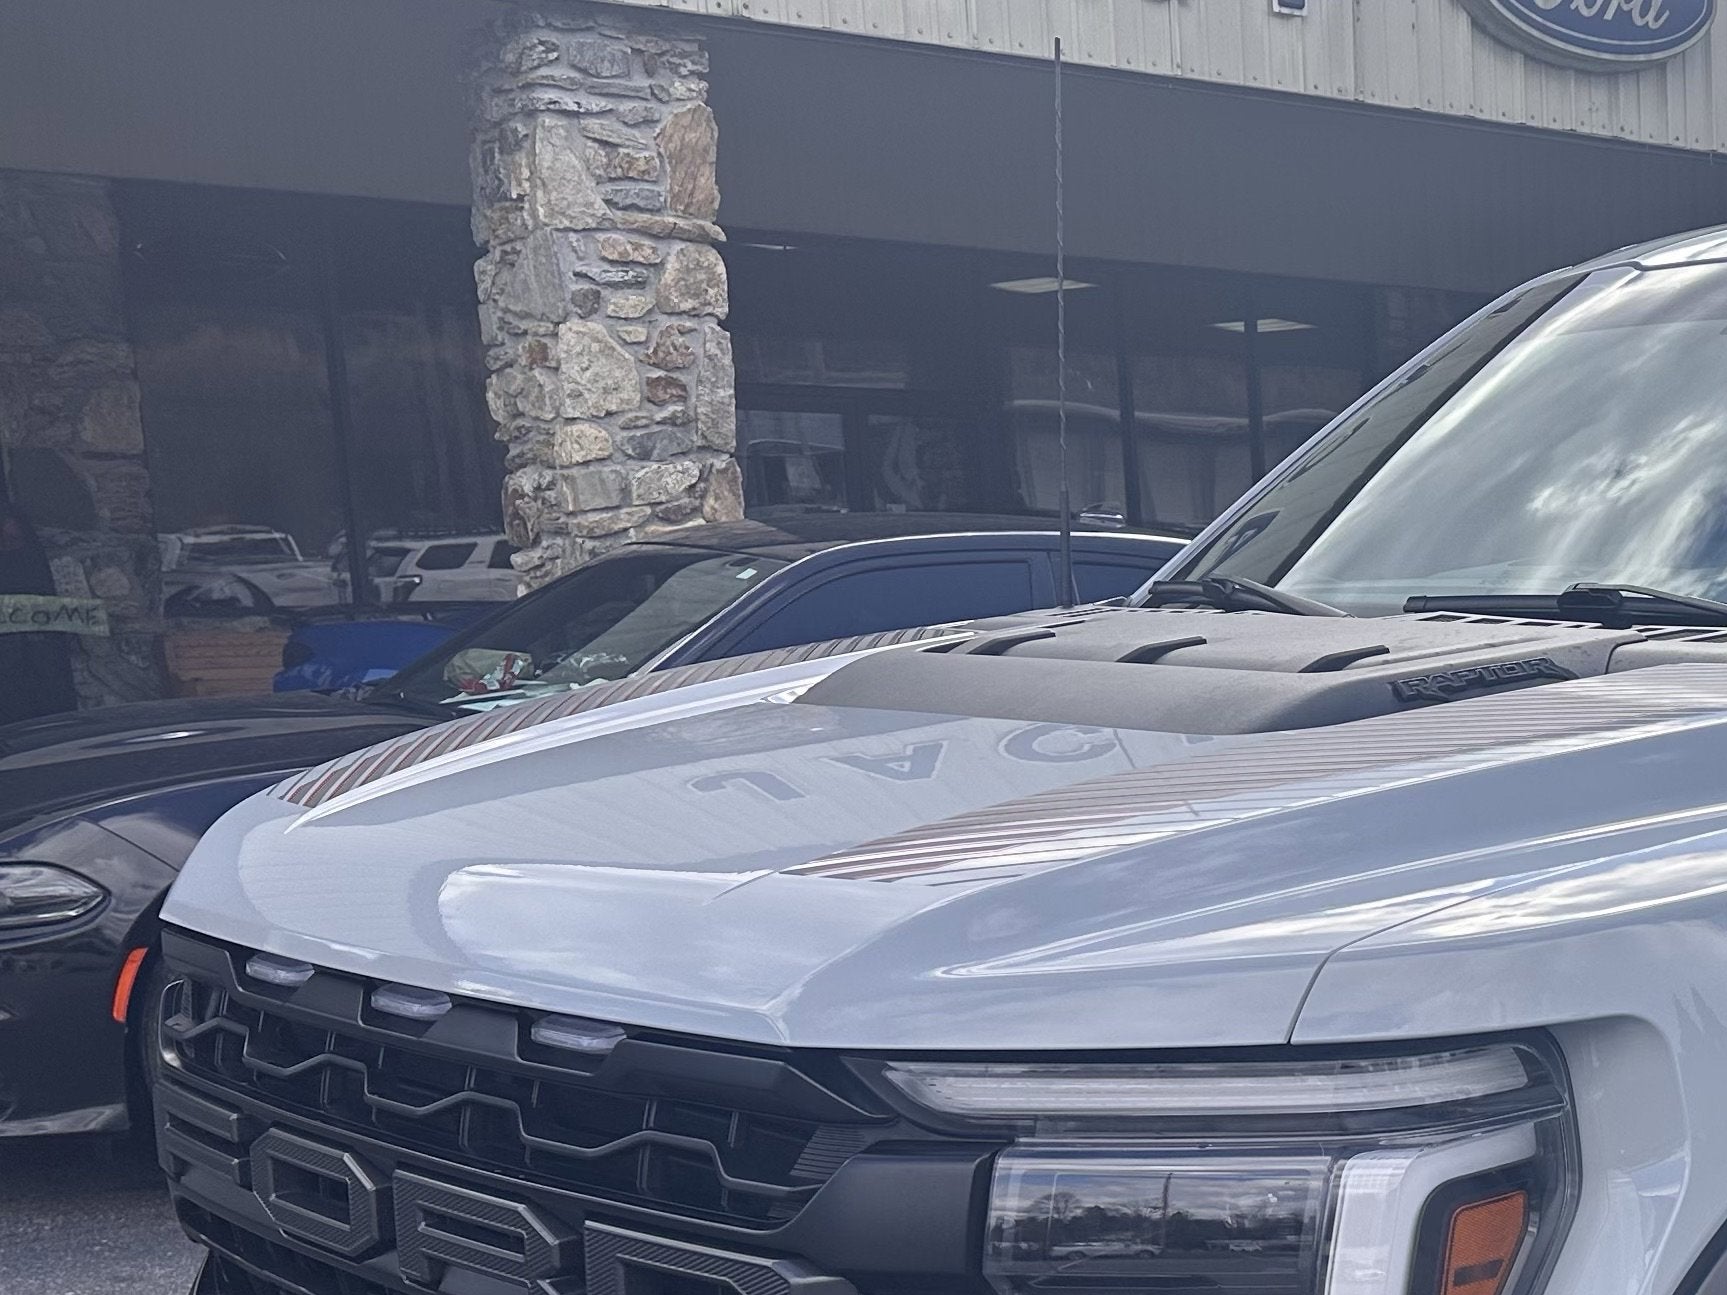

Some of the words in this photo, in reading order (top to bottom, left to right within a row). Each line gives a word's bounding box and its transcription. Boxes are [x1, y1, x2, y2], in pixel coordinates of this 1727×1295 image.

[1534, 0, 1671, 31] ord
[0, 603, 99, 627] COME
[1400, 656, 1560, 697] RAPTOR
